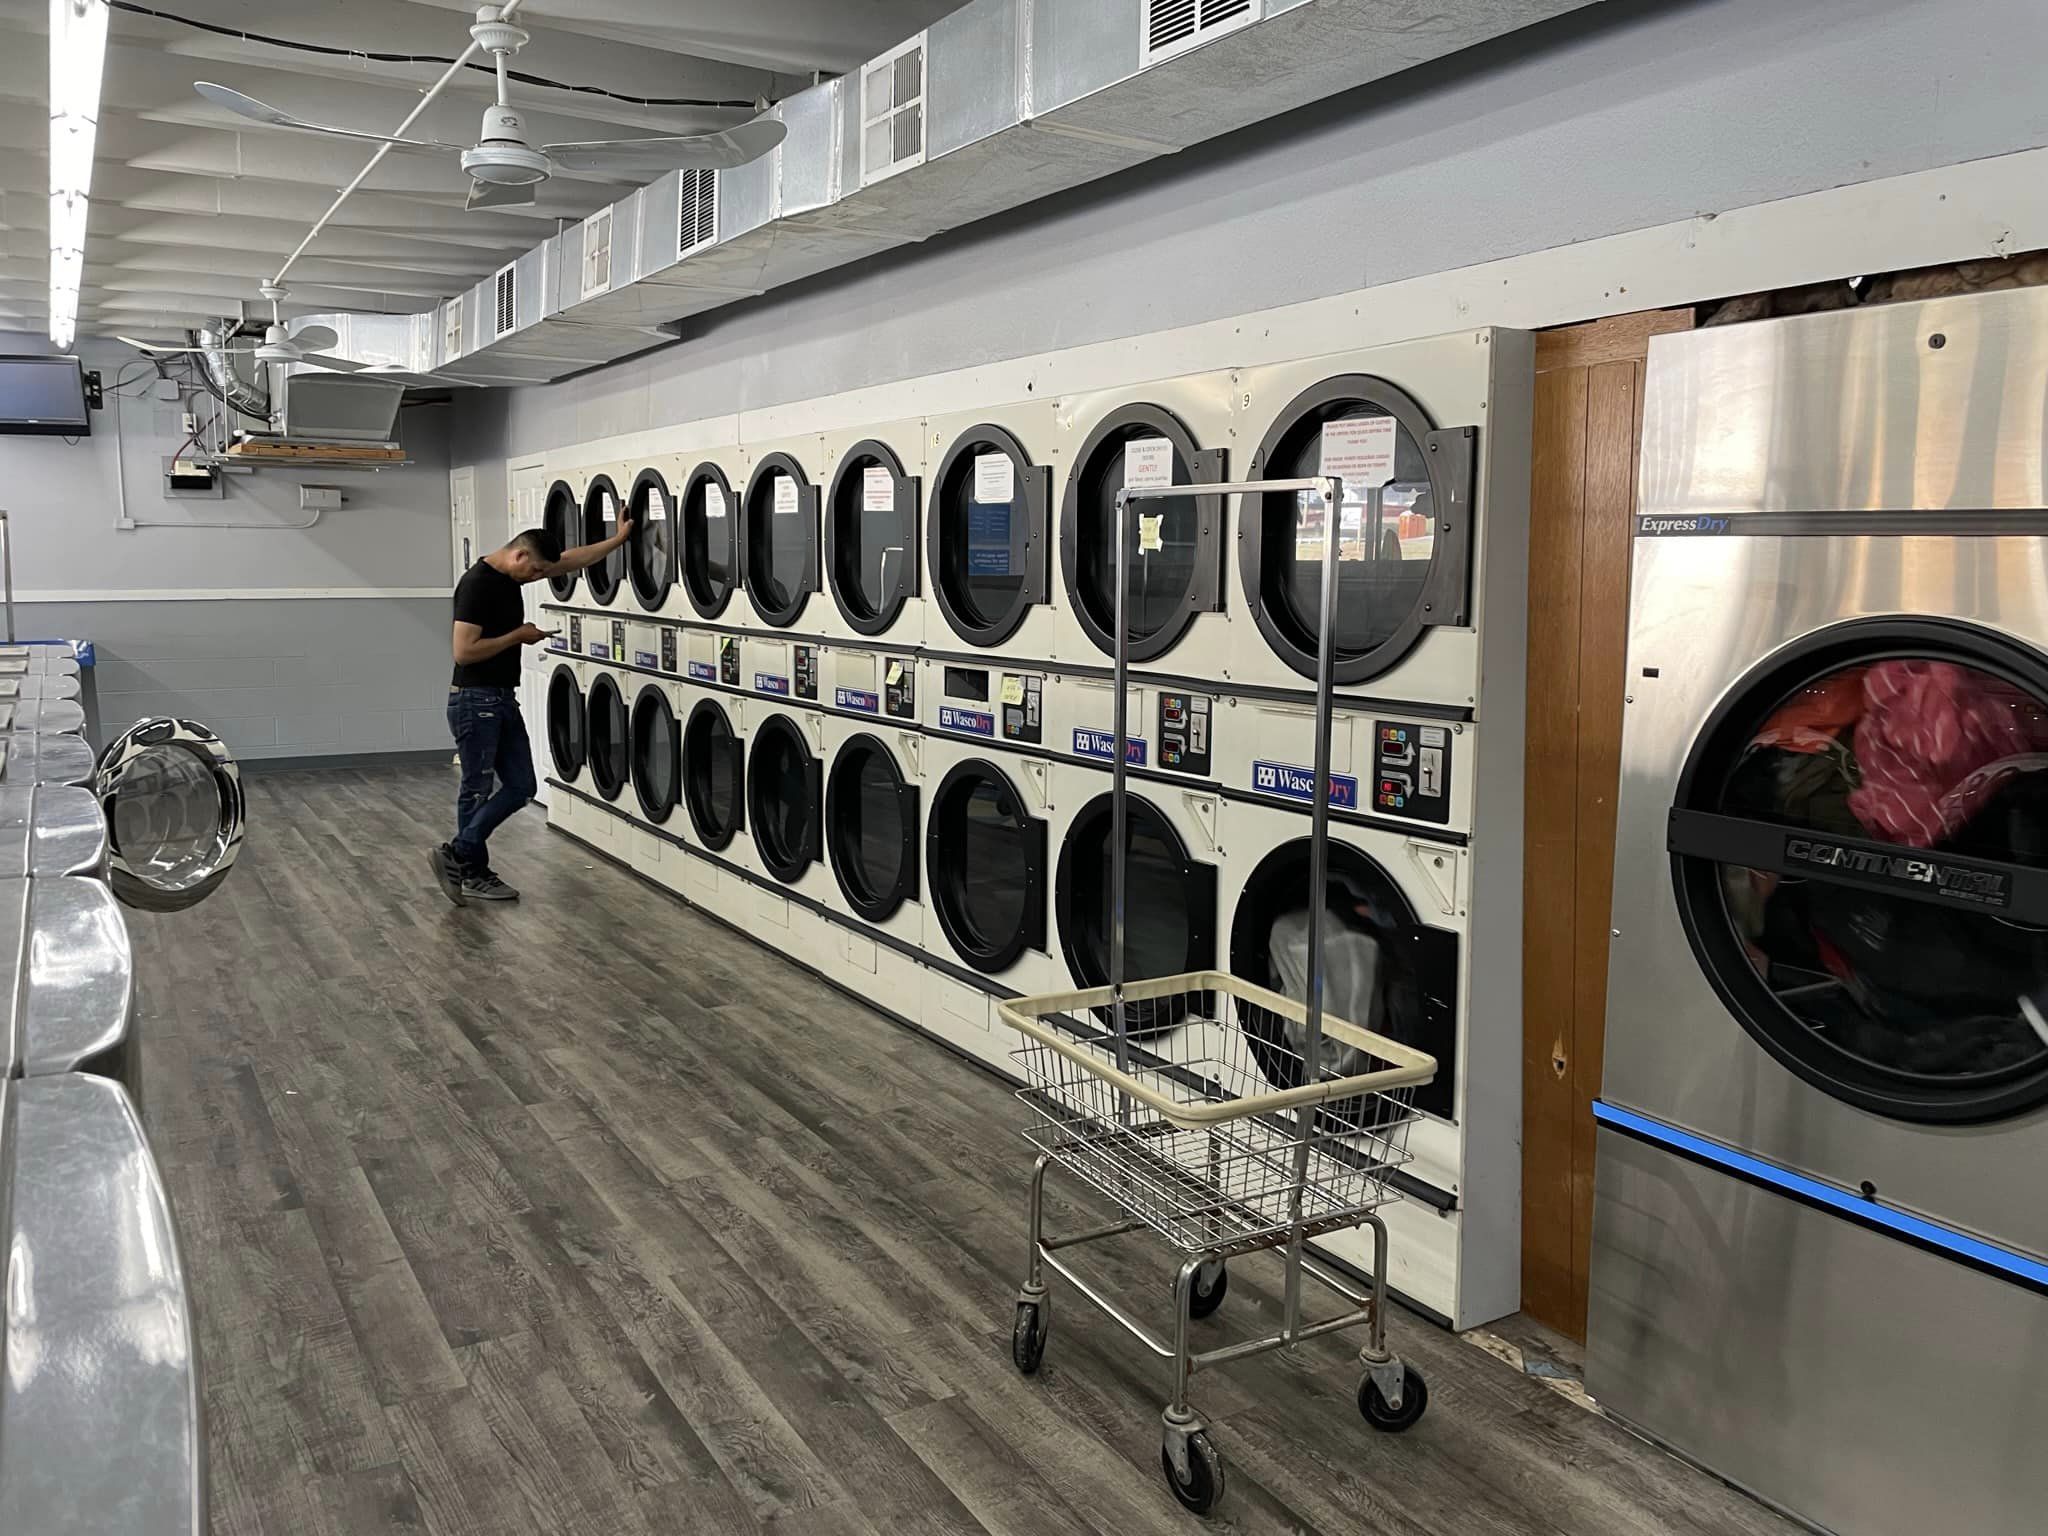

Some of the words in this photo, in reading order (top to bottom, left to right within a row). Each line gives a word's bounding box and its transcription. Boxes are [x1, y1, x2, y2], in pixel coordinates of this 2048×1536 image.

[1243, 393, 1250, 408] 9
[1641, 515, 1729, 535] ExpressDry
[845, 691, 876, 709] WascoDry
[952, 710, 992, 734] WascoDry
[1786, 839, 2005, 891] CONTINENTAL
